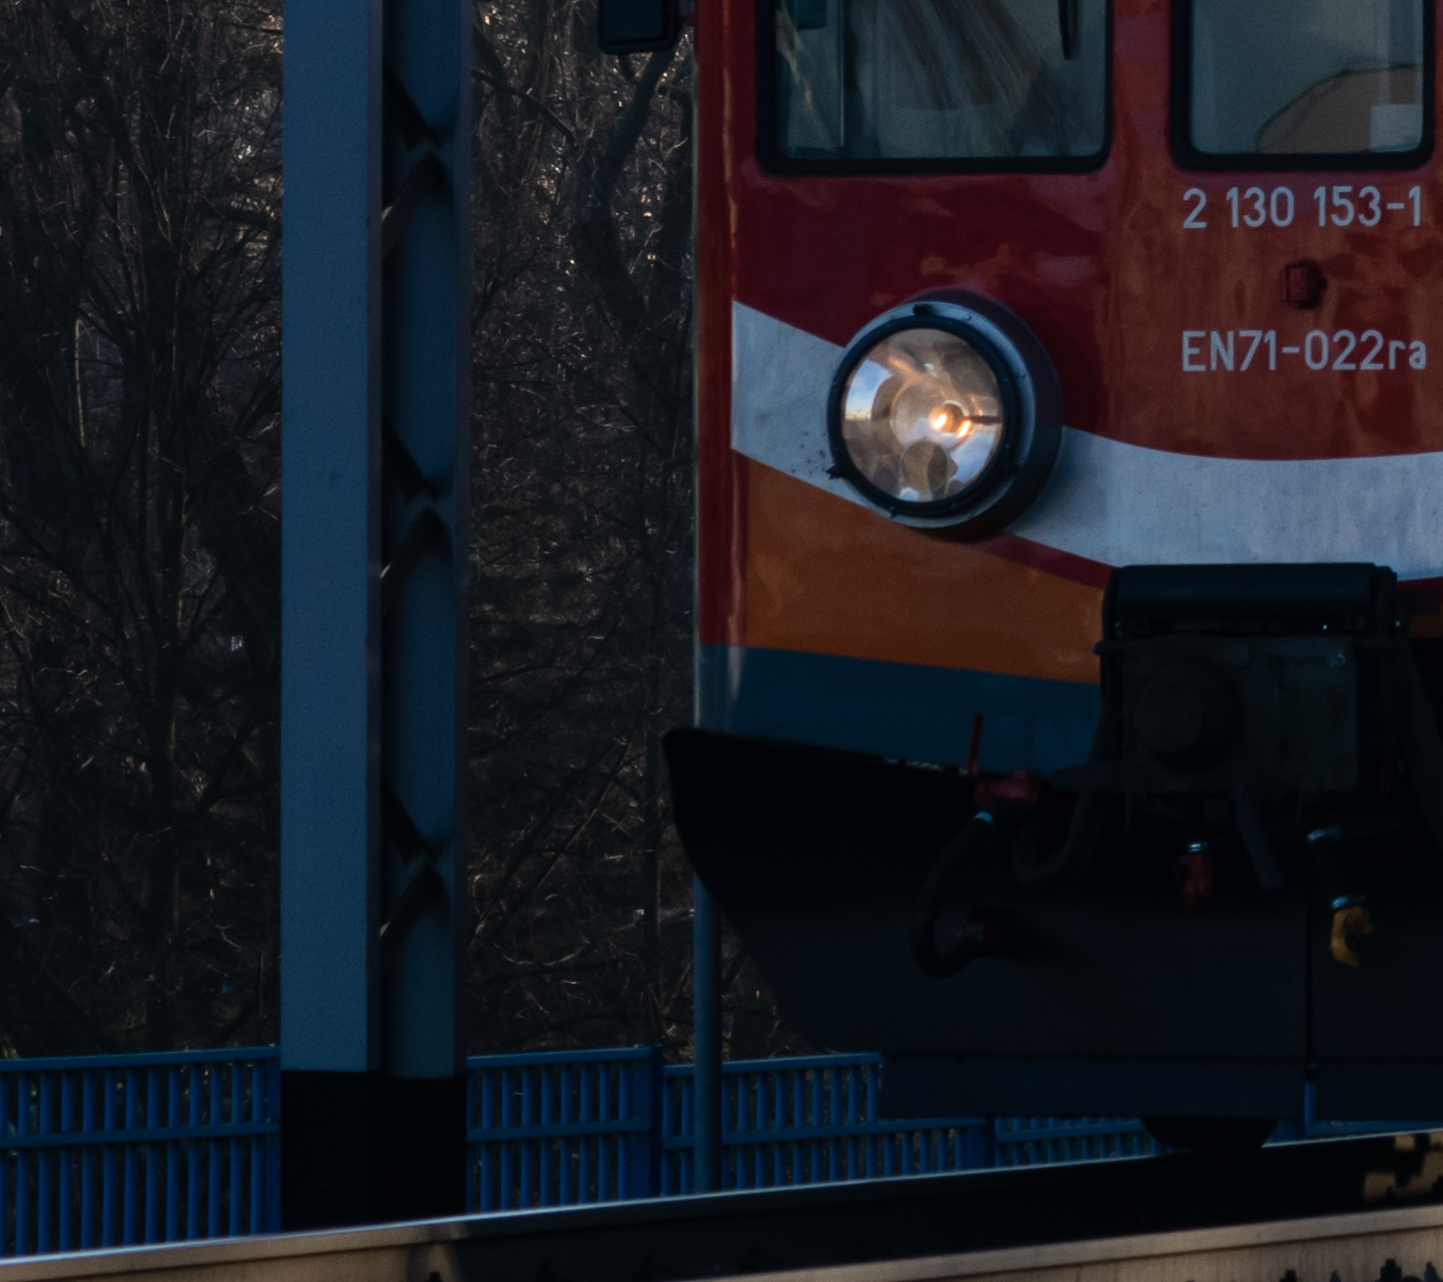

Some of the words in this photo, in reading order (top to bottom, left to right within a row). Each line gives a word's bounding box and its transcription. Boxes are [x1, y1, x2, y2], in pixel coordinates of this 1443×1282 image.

[1182, 187, 1207, 229] 2
[1225, 186, 1295, 229] 130
[1313, 185, 1421, 228] 153-1
[1181, 328, 1427, 372] EN71-022ra
